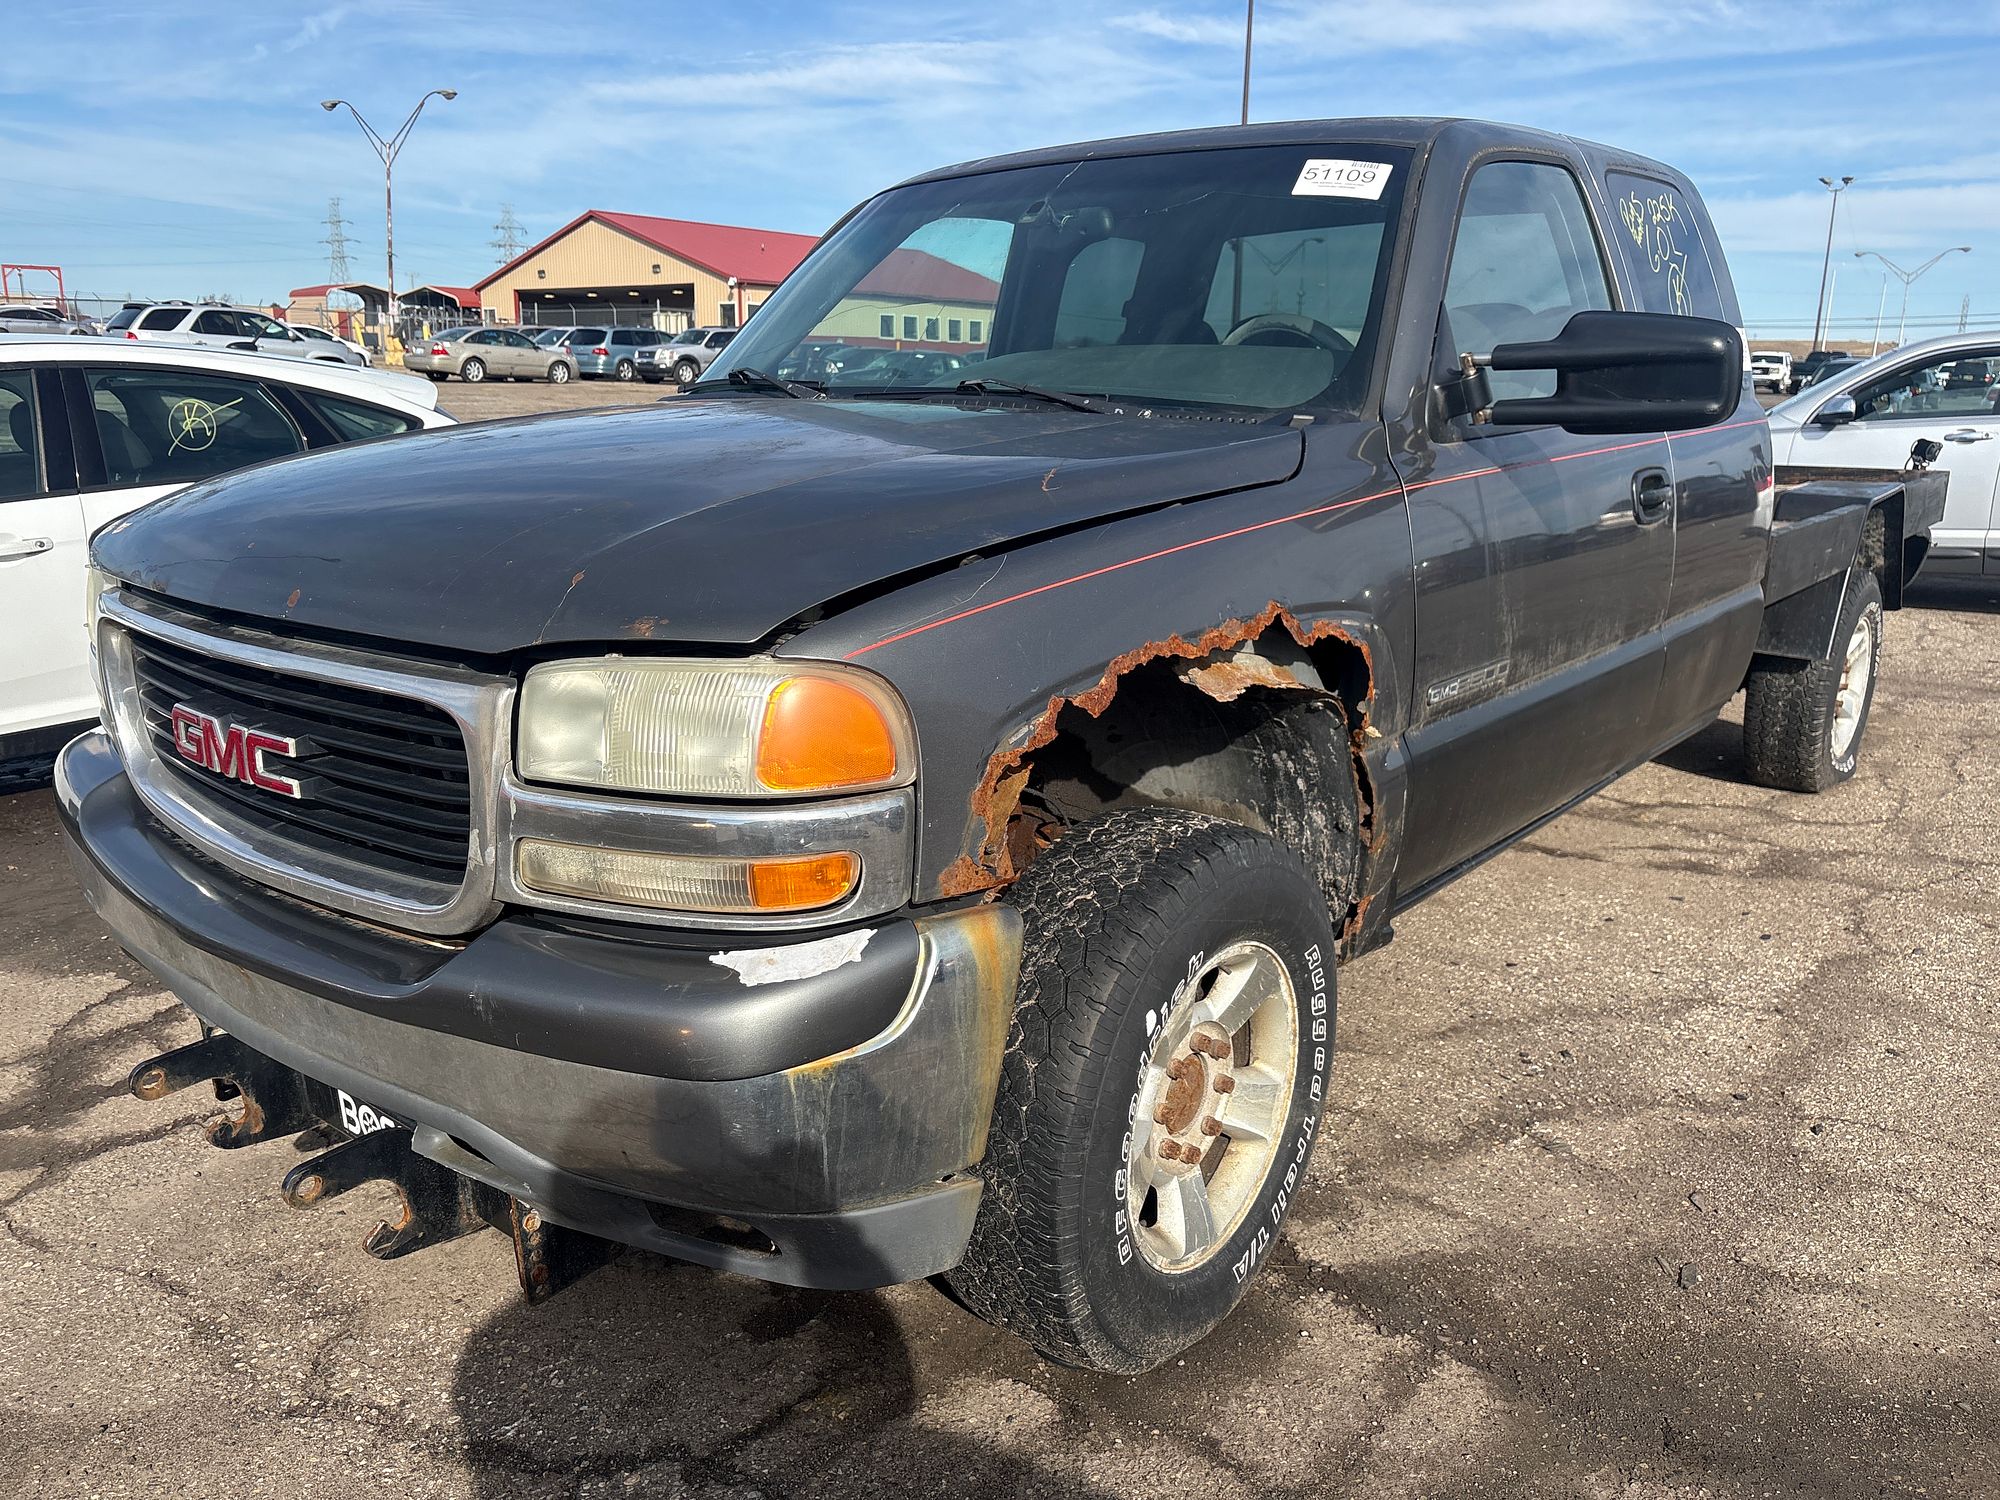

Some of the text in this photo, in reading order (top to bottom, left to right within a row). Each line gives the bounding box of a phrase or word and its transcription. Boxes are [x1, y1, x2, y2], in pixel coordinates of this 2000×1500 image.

[1303, 167, 1377, 184] 51109
[171, 702, 302, 800] GMC
[1304, 943, 1327, 1103] Rugged
[1271, 1115, 1316, 1225] Trail
